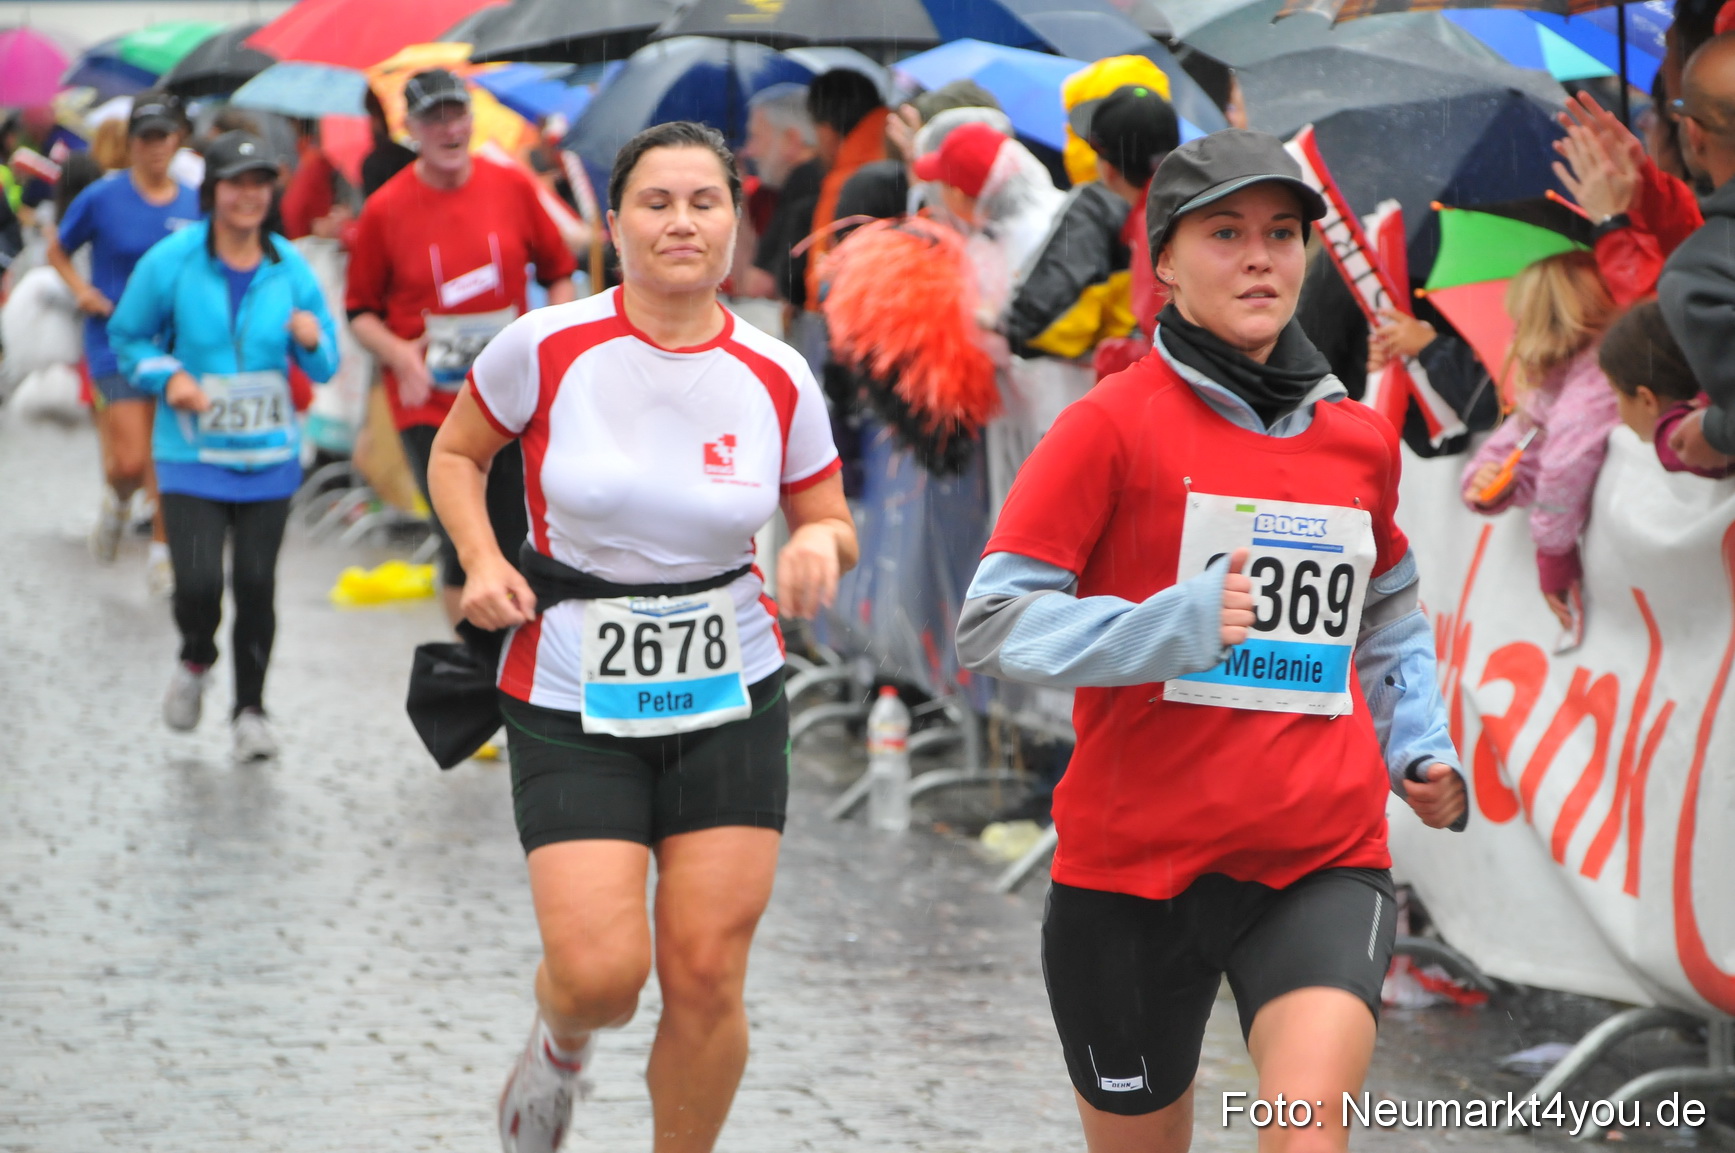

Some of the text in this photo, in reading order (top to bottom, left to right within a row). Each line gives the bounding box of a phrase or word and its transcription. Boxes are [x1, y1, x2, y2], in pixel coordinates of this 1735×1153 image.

[1253, 513, 1327, 538] BOCK
[1204, 552, 1355, 638] 369
[598, 614, 727, 677] 2678
[1223, 648, 1323, 684] Melanie
[638, 691, 694, 712] Petra
